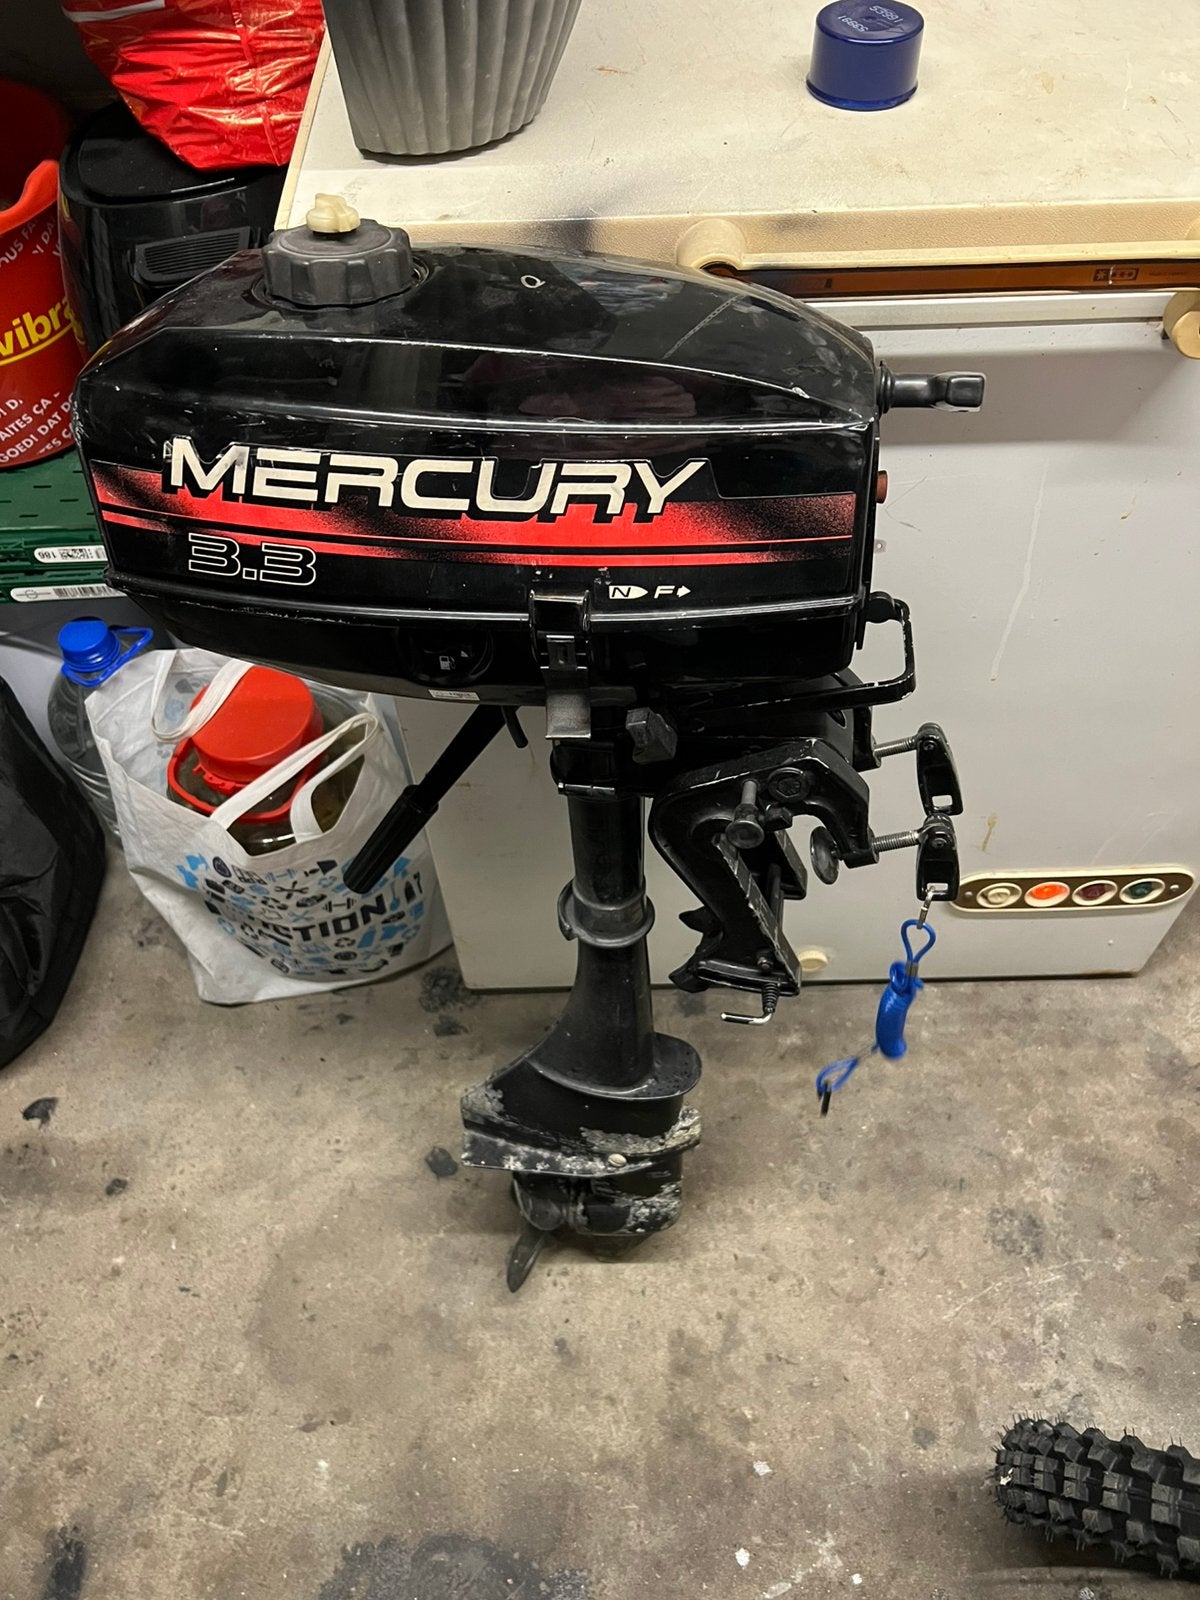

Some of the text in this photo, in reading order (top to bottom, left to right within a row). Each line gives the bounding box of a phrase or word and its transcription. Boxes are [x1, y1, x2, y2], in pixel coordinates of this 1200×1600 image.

[37, 411, 62, 436] DAT
[170, 438, 706, 514] MERCURY
[188, 532, 317, 587] 3.3
[611, 586, 675, 599] N F
